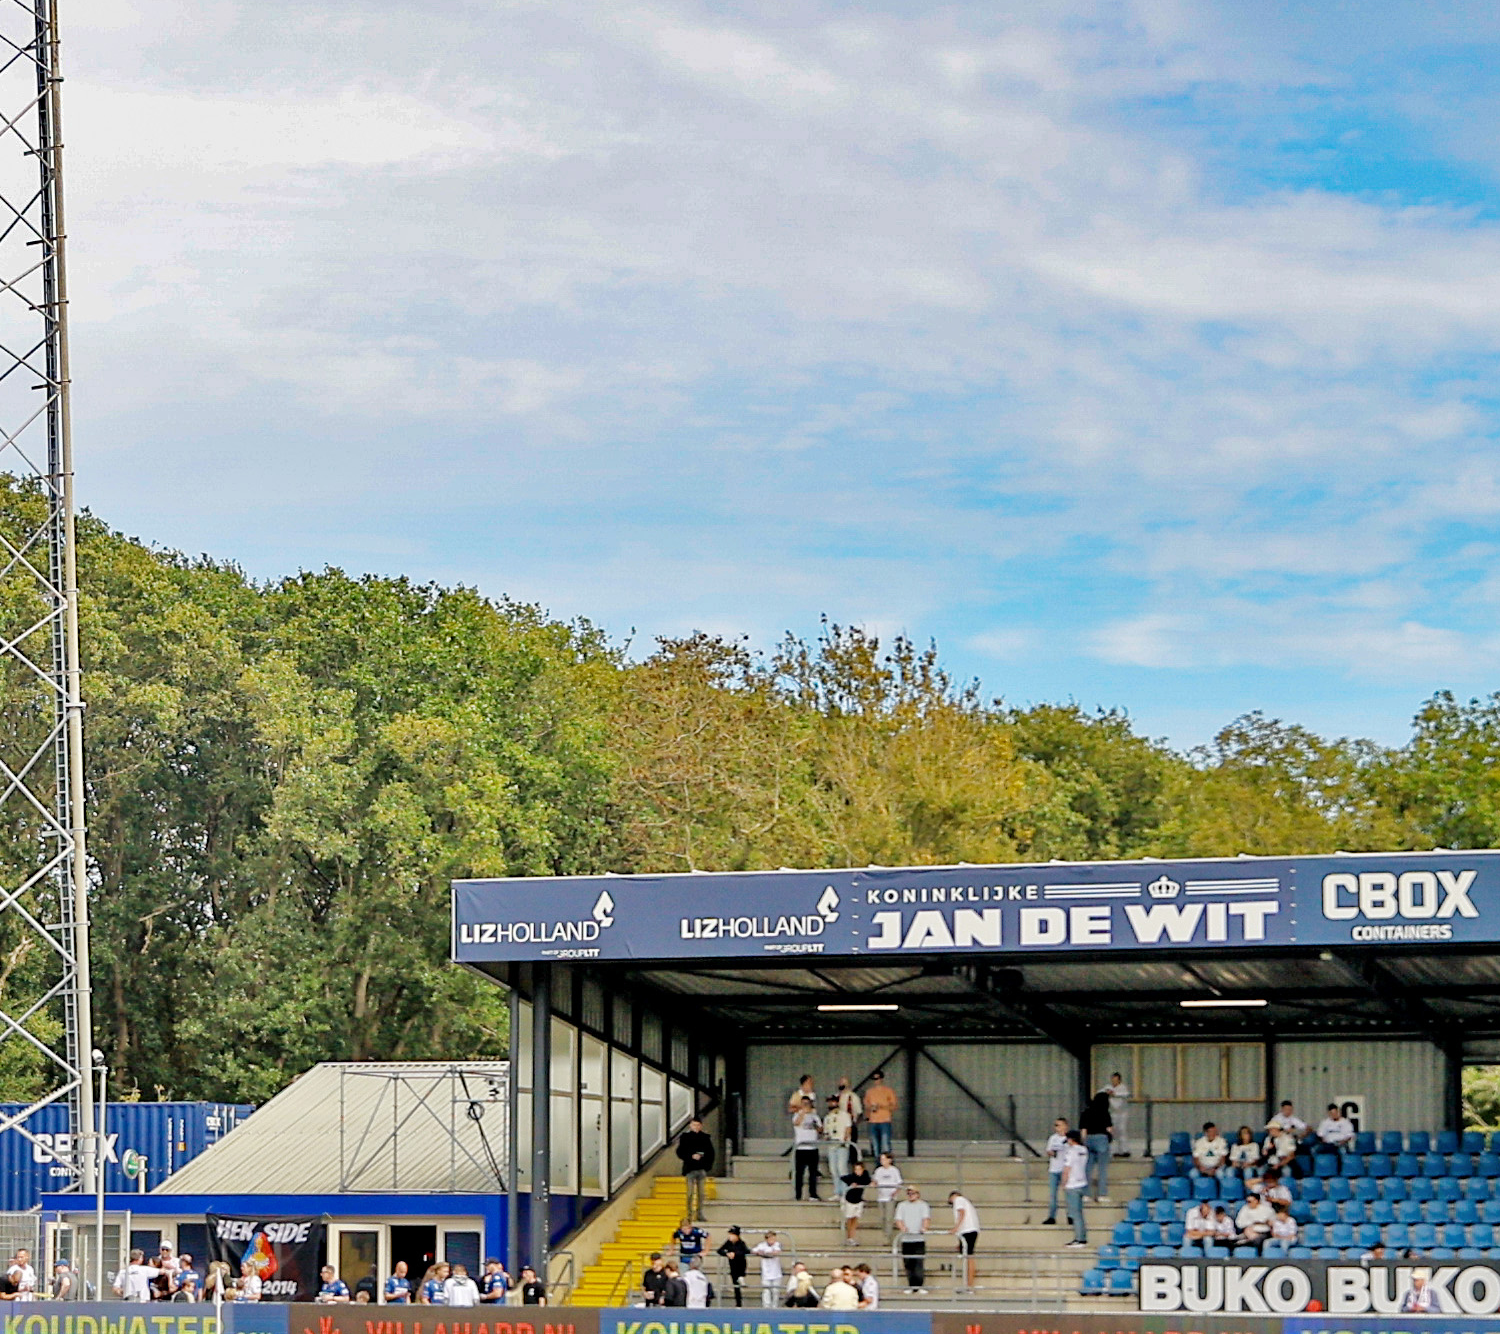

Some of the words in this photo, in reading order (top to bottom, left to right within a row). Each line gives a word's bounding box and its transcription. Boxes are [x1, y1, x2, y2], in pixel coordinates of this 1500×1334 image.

[868, 885, 1039, 905] KONINKLIJKE
[1322, 870, 1480, 920] CBOX
[868, 909, 1002, 949] JAN
[1020, 906, 1112, 946] DE
[1124, 901, 1280, 944] WIT
[1351, 924, 1453, 941] CONTAINERS
[216, 1219, 258, 1242] HEK
[263, 1222, 311, 1243] SIDE
[262, 1280, 298, 1295] 2014
